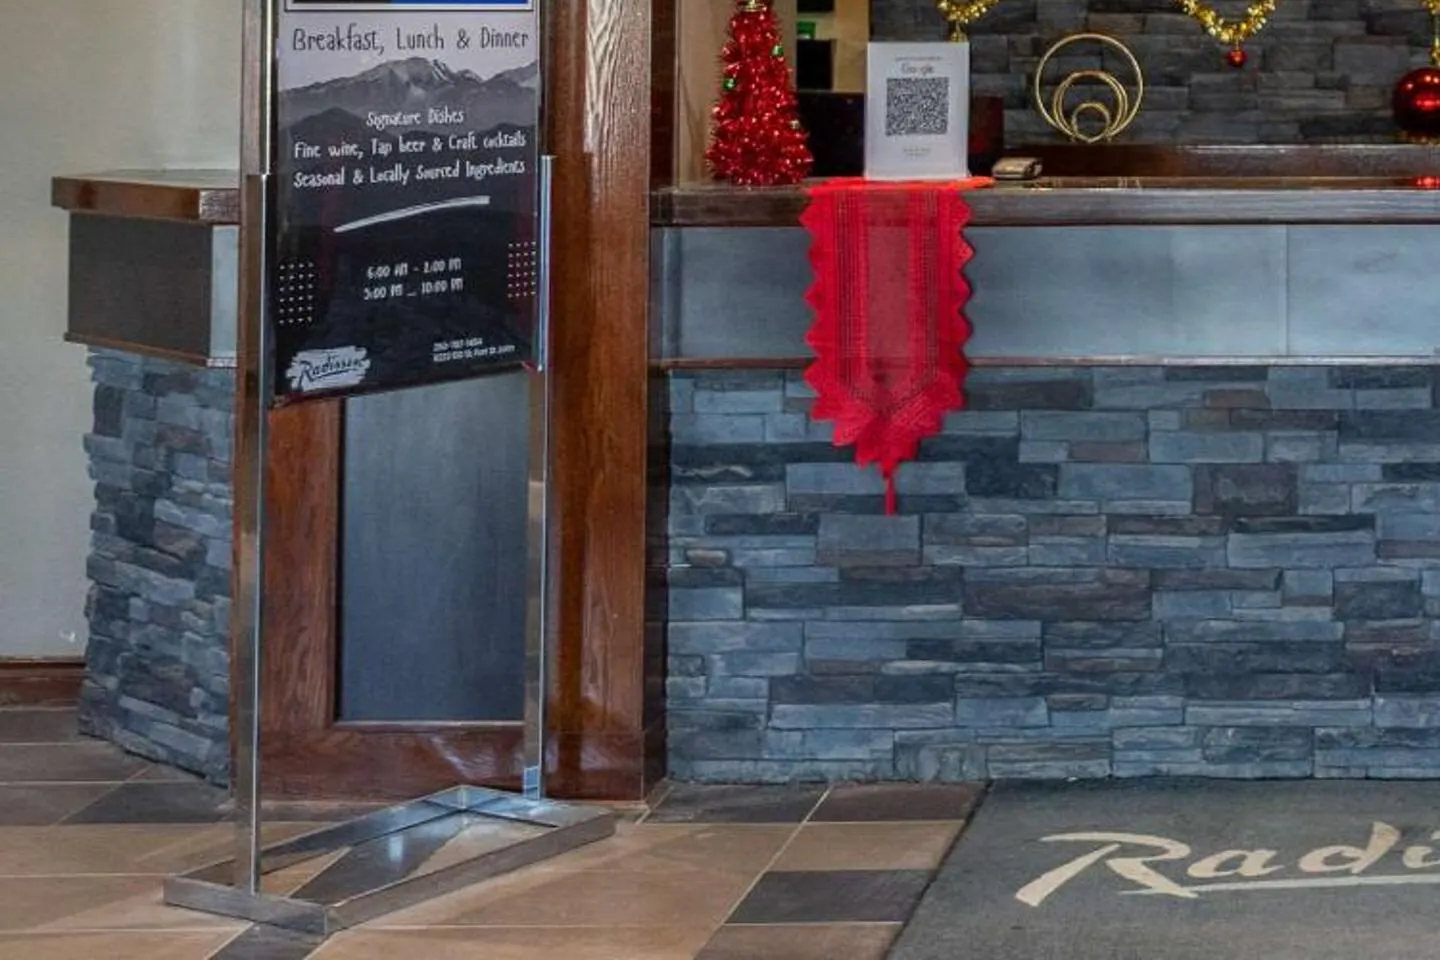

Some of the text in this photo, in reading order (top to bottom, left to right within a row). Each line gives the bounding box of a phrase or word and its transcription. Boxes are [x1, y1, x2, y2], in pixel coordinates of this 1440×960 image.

[292, 23, 529, 54] Breakfast, Lunch & Dinner
[901, 62, 935, 76] Gogle
[366, 105, 464, 131] Signature Dishes
[295, 130, 526, 160] Fine wine, Tap beer & Craft cocktails
[293, 156, 526, 188] Seasonal & Locally Sourced Ingredients
